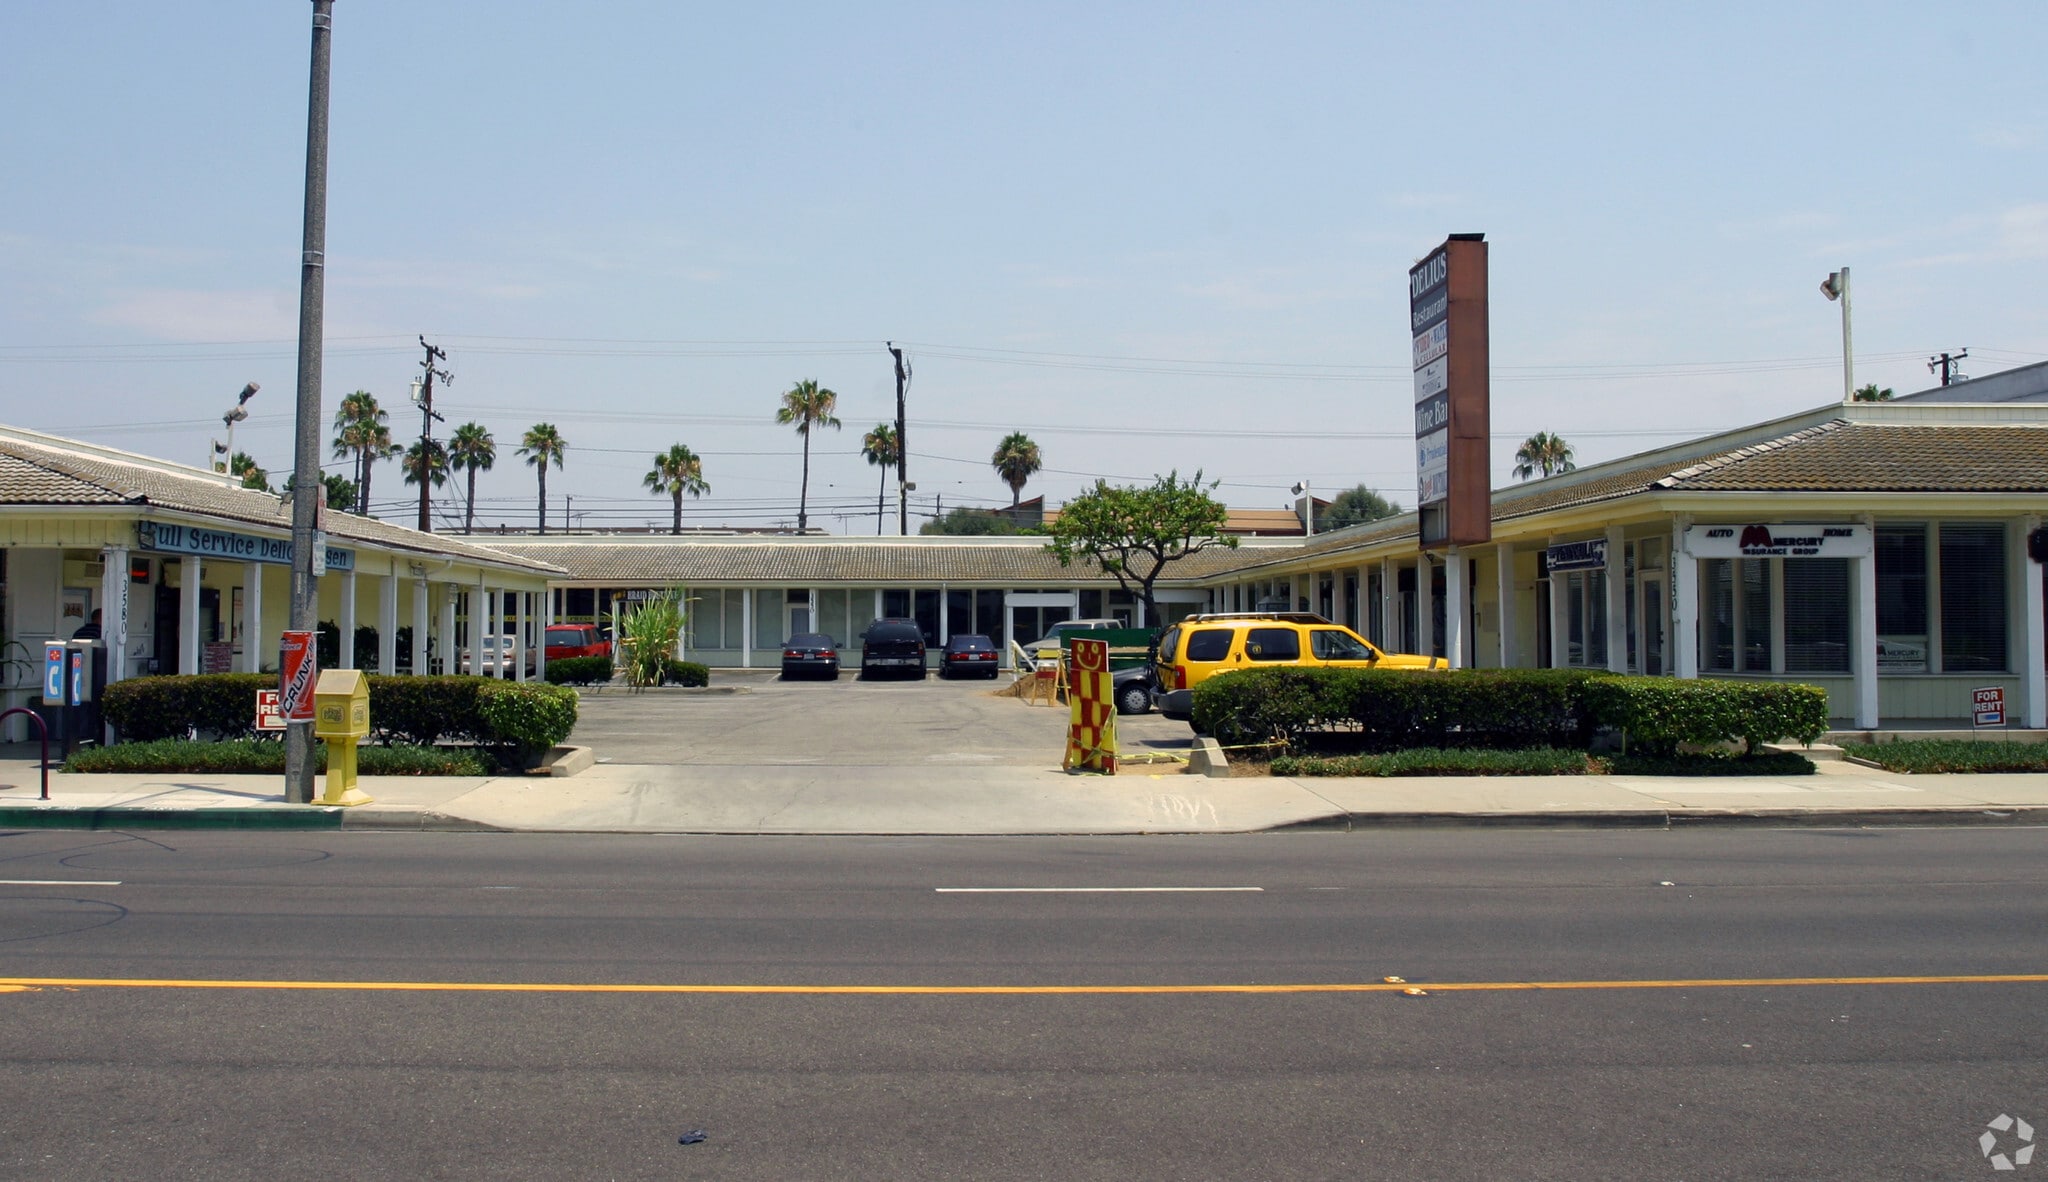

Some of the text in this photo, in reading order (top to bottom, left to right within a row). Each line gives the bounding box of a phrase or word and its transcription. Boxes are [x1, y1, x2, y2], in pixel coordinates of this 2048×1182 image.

[1411, 251, 1447, 298] DELIUS
[1416, 407, 1434, 433] Wine
[1706, 528, 1853, 538] AUTO HOME
[1773, 537, 1824, 546] MERCURY
[189, 529, 254, 555] Service
[260, 539, 347, 566] Delicsen
[1977, 691, 1999, 702] FOR
[1975, 702, 2003, 713] RENT
